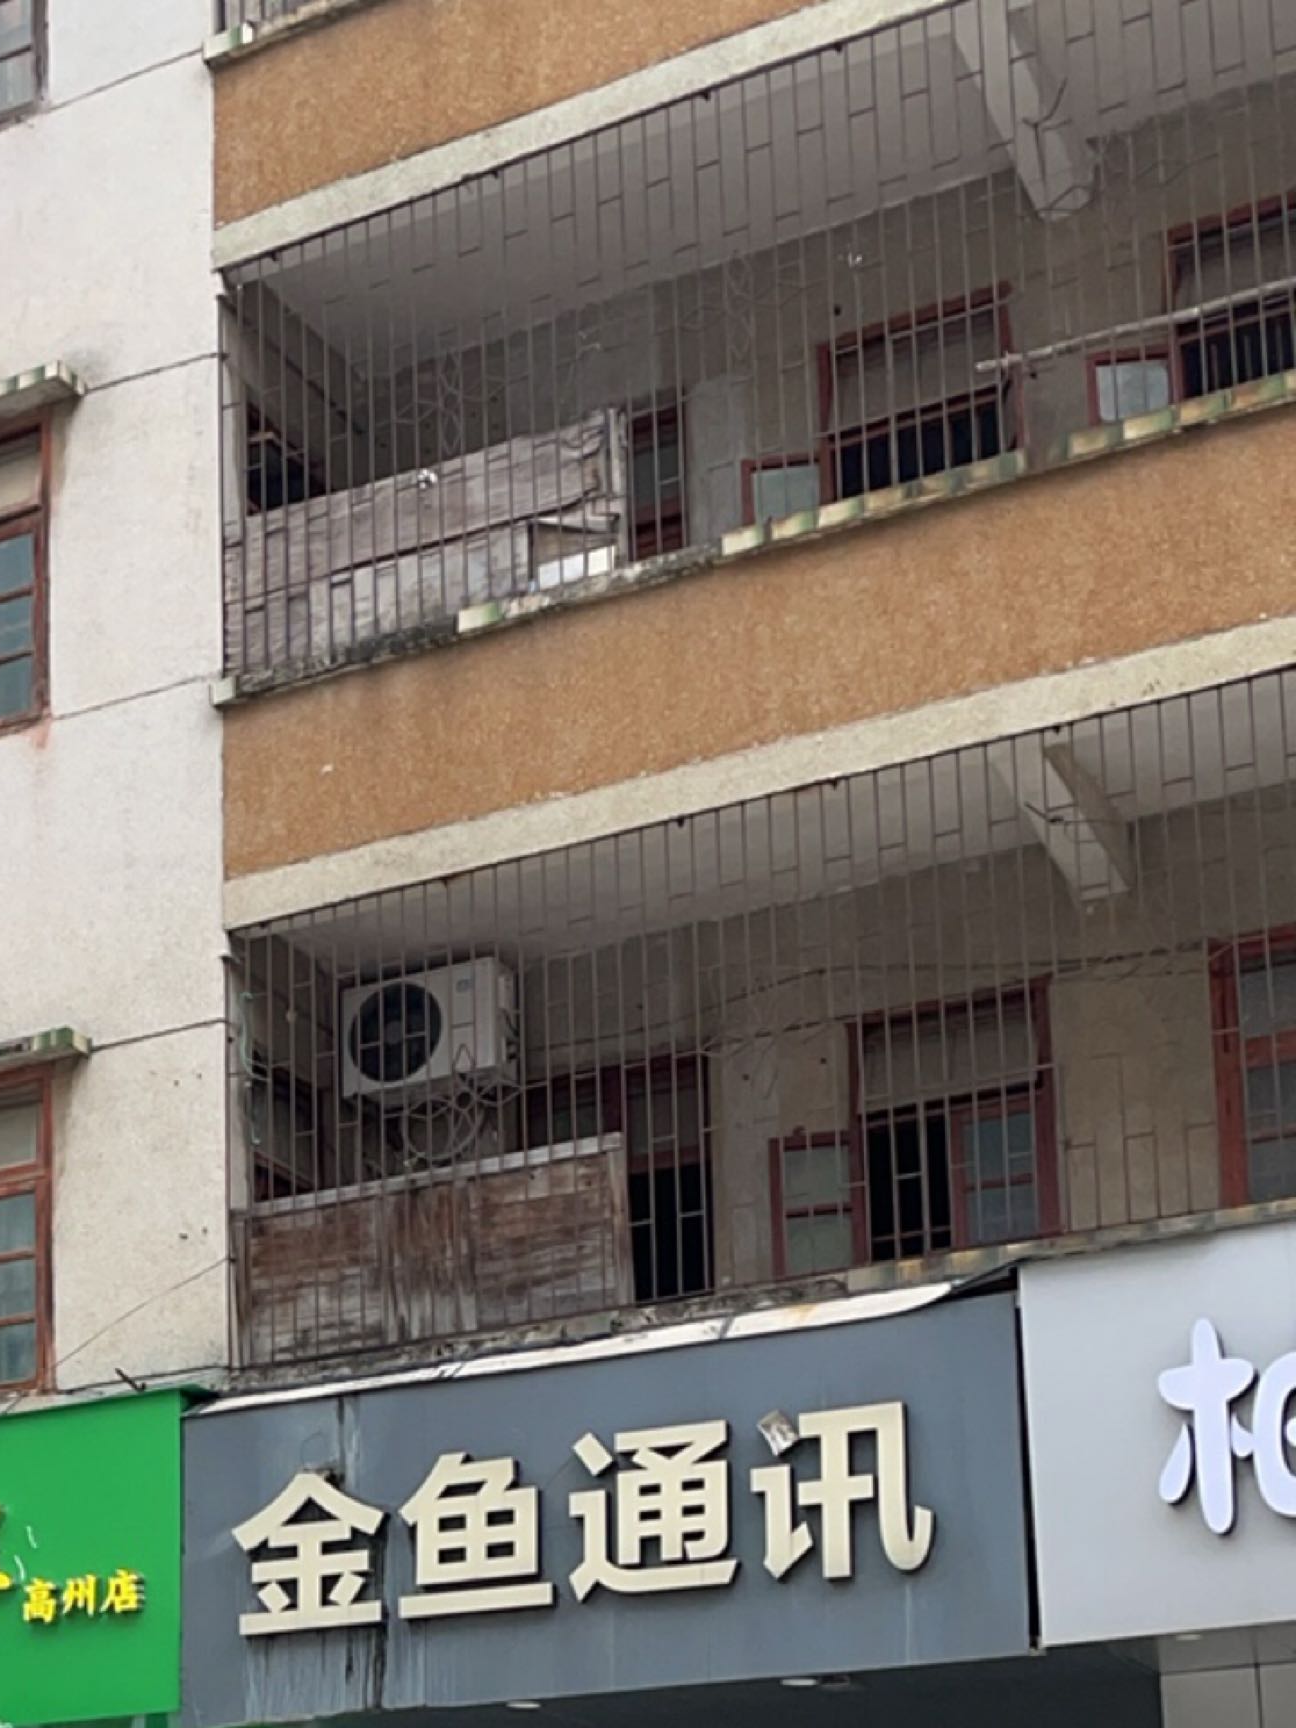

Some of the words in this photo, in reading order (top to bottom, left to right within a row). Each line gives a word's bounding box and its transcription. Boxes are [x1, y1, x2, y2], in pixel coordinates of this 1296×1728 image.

[232, 1400, 935, 1637] 金鱼通讯
[22, 1569, 142, 1624] 高州店
